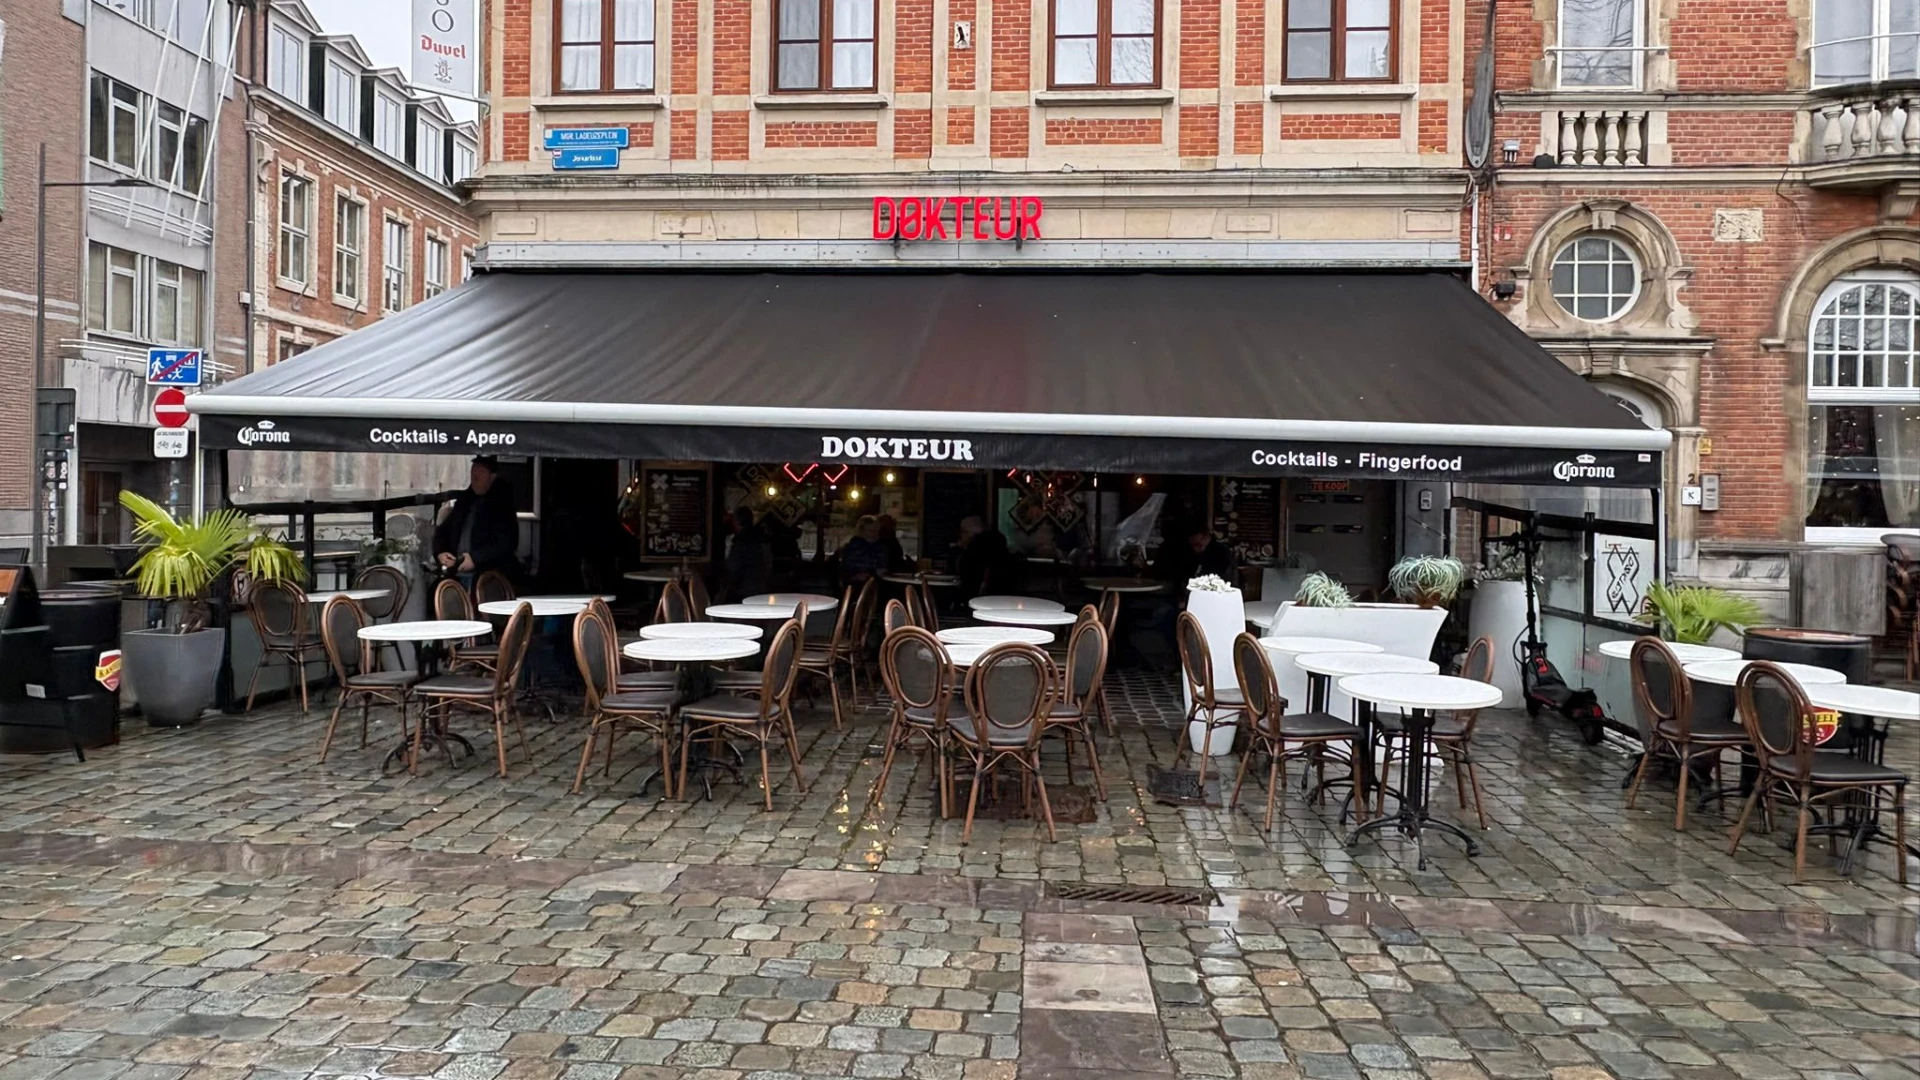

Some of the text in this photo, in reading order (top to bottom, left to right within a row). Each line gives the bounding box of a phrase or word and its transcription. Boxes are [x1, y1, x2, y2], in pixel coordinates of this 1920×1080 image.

[421, 35, 466, 59] Duvel
[237, 427, 290, 446] Corona
[369, 428, 448, 444] Cocktails
[466, 429, 516, 447] Apero
[821, 436, 974, 461] DOKTEUR
[1251, 450, 1338, 467] Cocktails
[1359, 453, 1462, 472] Fingerfood
[1553, 461, 1615, 482] Corona
[1688, 473, 1695, 484] 2
[1688, 491, 1694, 499] K
